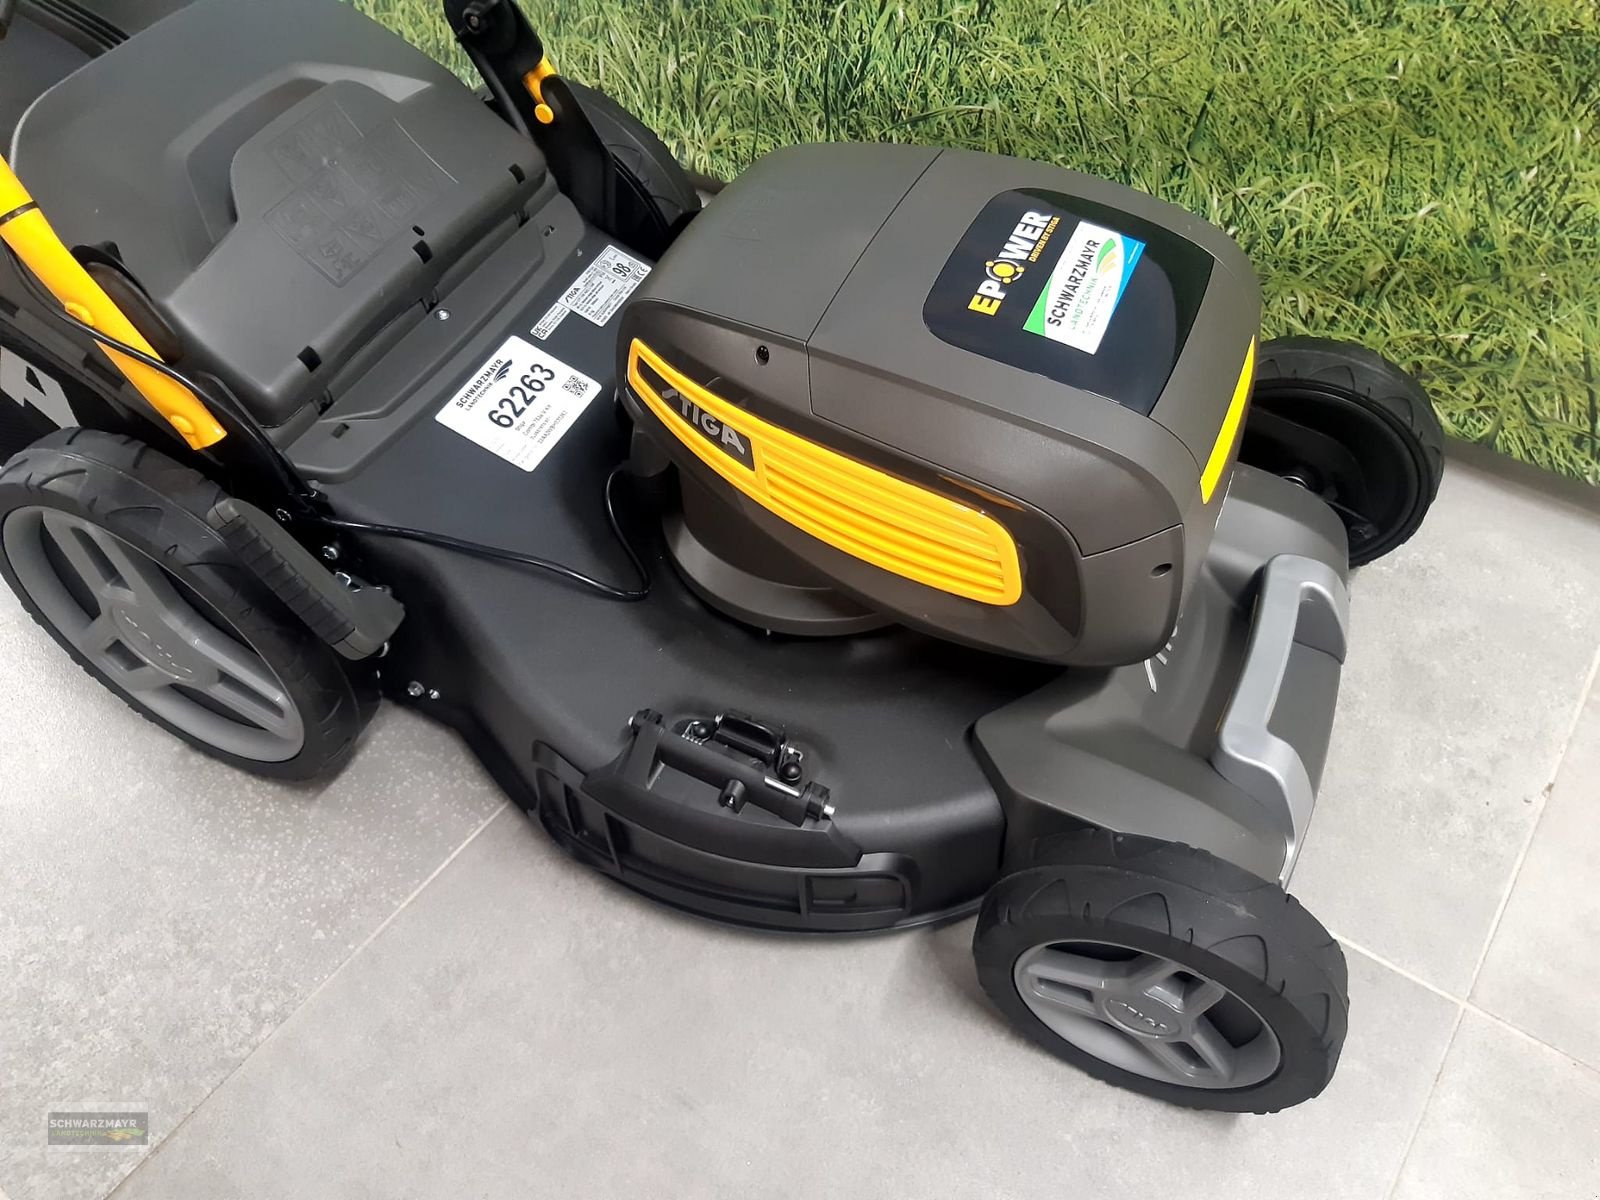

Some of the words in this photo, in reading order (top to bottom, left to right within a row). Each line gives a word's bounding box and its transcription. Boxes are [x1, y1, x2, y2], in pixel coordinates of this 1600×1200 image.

[967, 211, 1052, 316] EPOWER
[1028, 239, 1046, 263] DRIVEN
[1045, 216, 1060, 233] STIGA
[565, 287, 580, 303] STIGA
[613, 263, 631, 277] 98
[1047, 239, 1100, 327] SCHWARZMAYR
[1071, 278, 1098, 330] LANDTECHNIK
[456, 359, 504, 408] SCHWARZMAYR
[465, 382, 493, 411] LANDTECHNIK
[488, 363, 555, 428] 62263
[662, 388, 745, 455] STIGA
